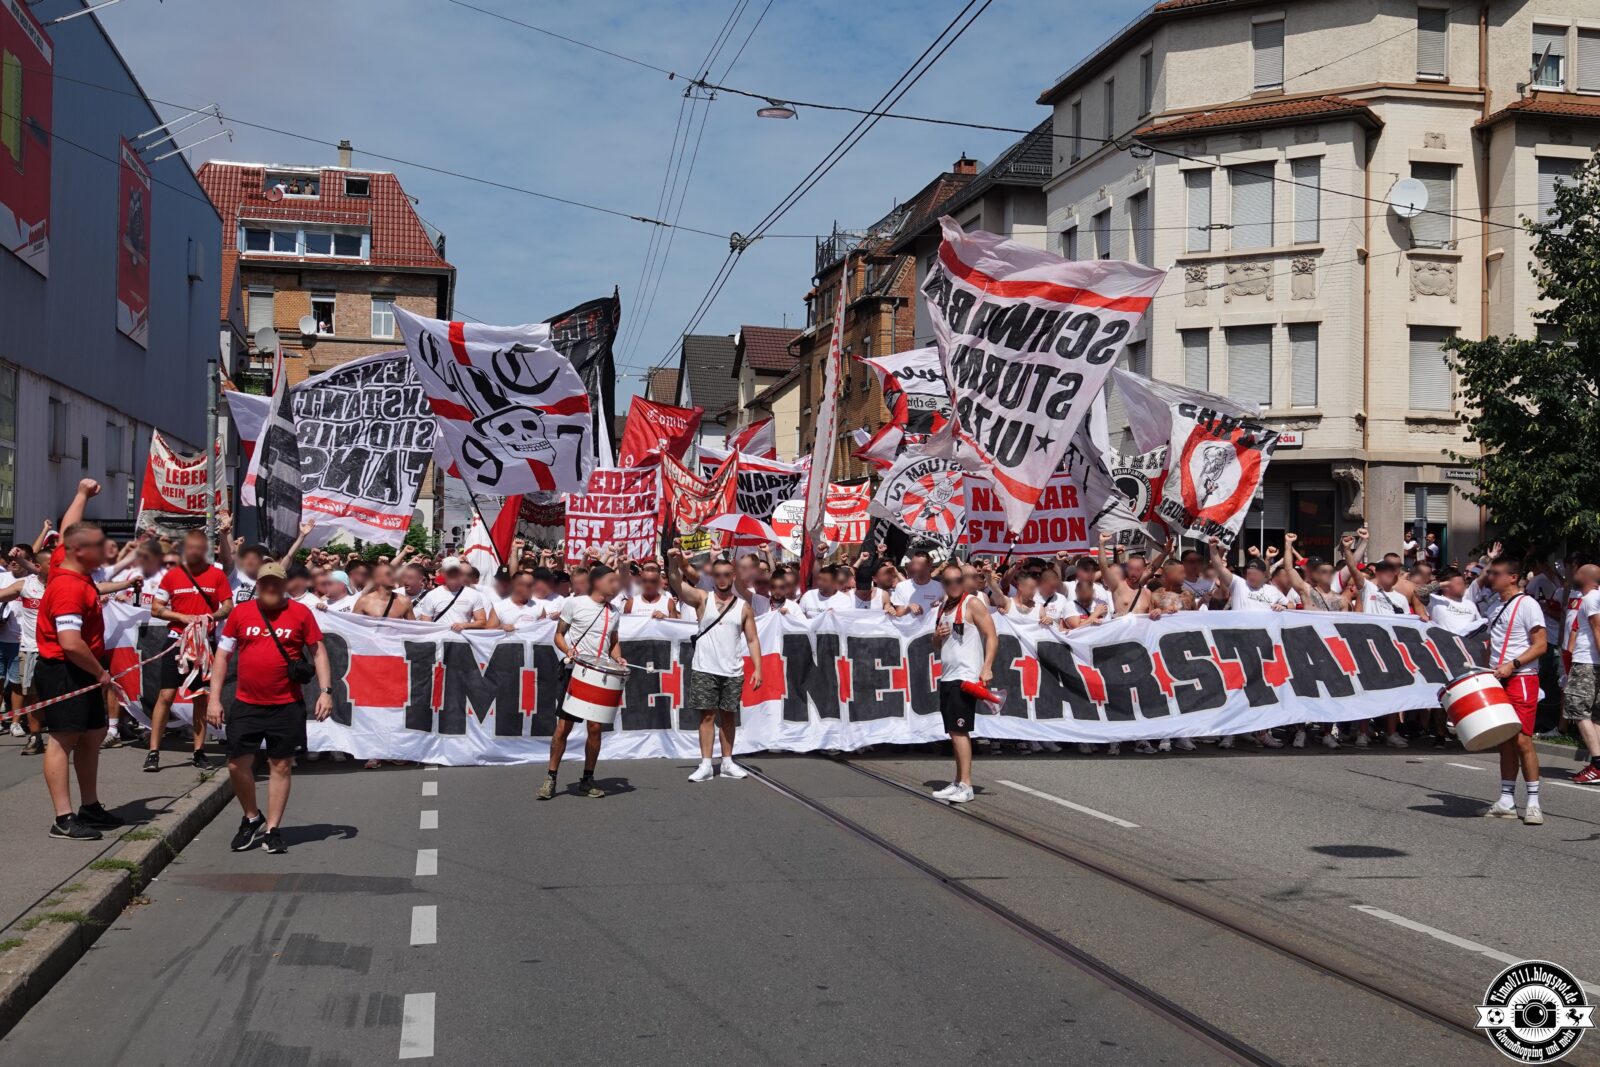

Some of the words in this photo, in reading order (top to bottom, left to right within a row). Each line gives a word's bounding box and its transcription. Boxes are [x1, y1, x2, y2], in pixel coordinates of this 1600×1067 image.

[1276, 433, 1296, 443] räu
[166, 467, 208, 486] LEBEN
[587, 469, 657, 495] EDER
[702, 465, 803, 492] SWABEN
[161, 485, 186, 499] MEIN
[186, 489, 222, 510] HEM
[569, 493, 656, 514] EINZELNE
[736, 490, 775, 516] URM
[971, 484, 1080, 512] NEAR
[568, 518, 605, 539] IST
[612, 516, 655, 539] DER
[590, 536, 655, 560] MNN
[246, 626, 261, 637] 19
[275, 628, 292, 639] 97
[403, 638, 743, 737] IME
[782, 622, 1491, 723] NECKARSTADIO
